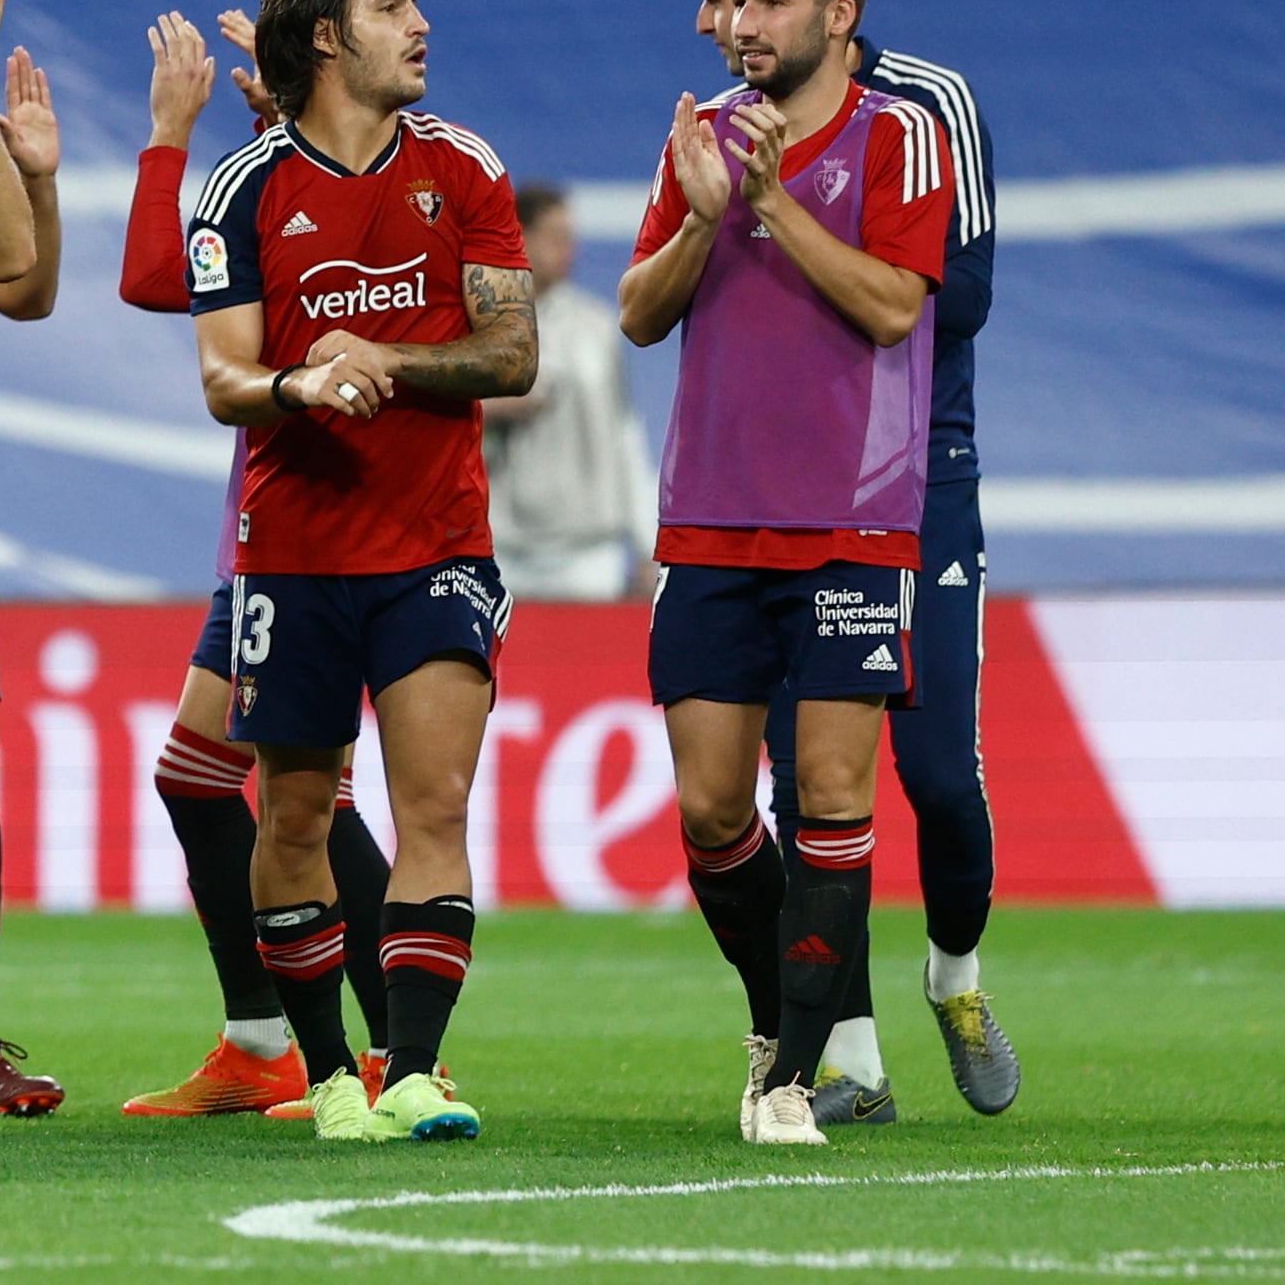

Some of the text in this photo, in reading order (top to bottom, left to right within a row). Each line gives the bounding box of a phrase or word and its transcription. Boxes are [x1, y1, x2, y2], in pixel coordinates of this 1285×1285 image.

[280, 223, 318, 237] adidas
[197, 271, 225, 285] LaLiga
[300, 272, 427, 320] verleal
[430, 582, 449, 597] de
[938, 577, 969, 587] adidas
[815, 589, 864, 606] Clínica
[816, 603, 899, 622] Universidad
[241, 593, 275, 665] 3
[817, 620, 896, 637] de Navarra
[862, 659, 898, 672] adidas
